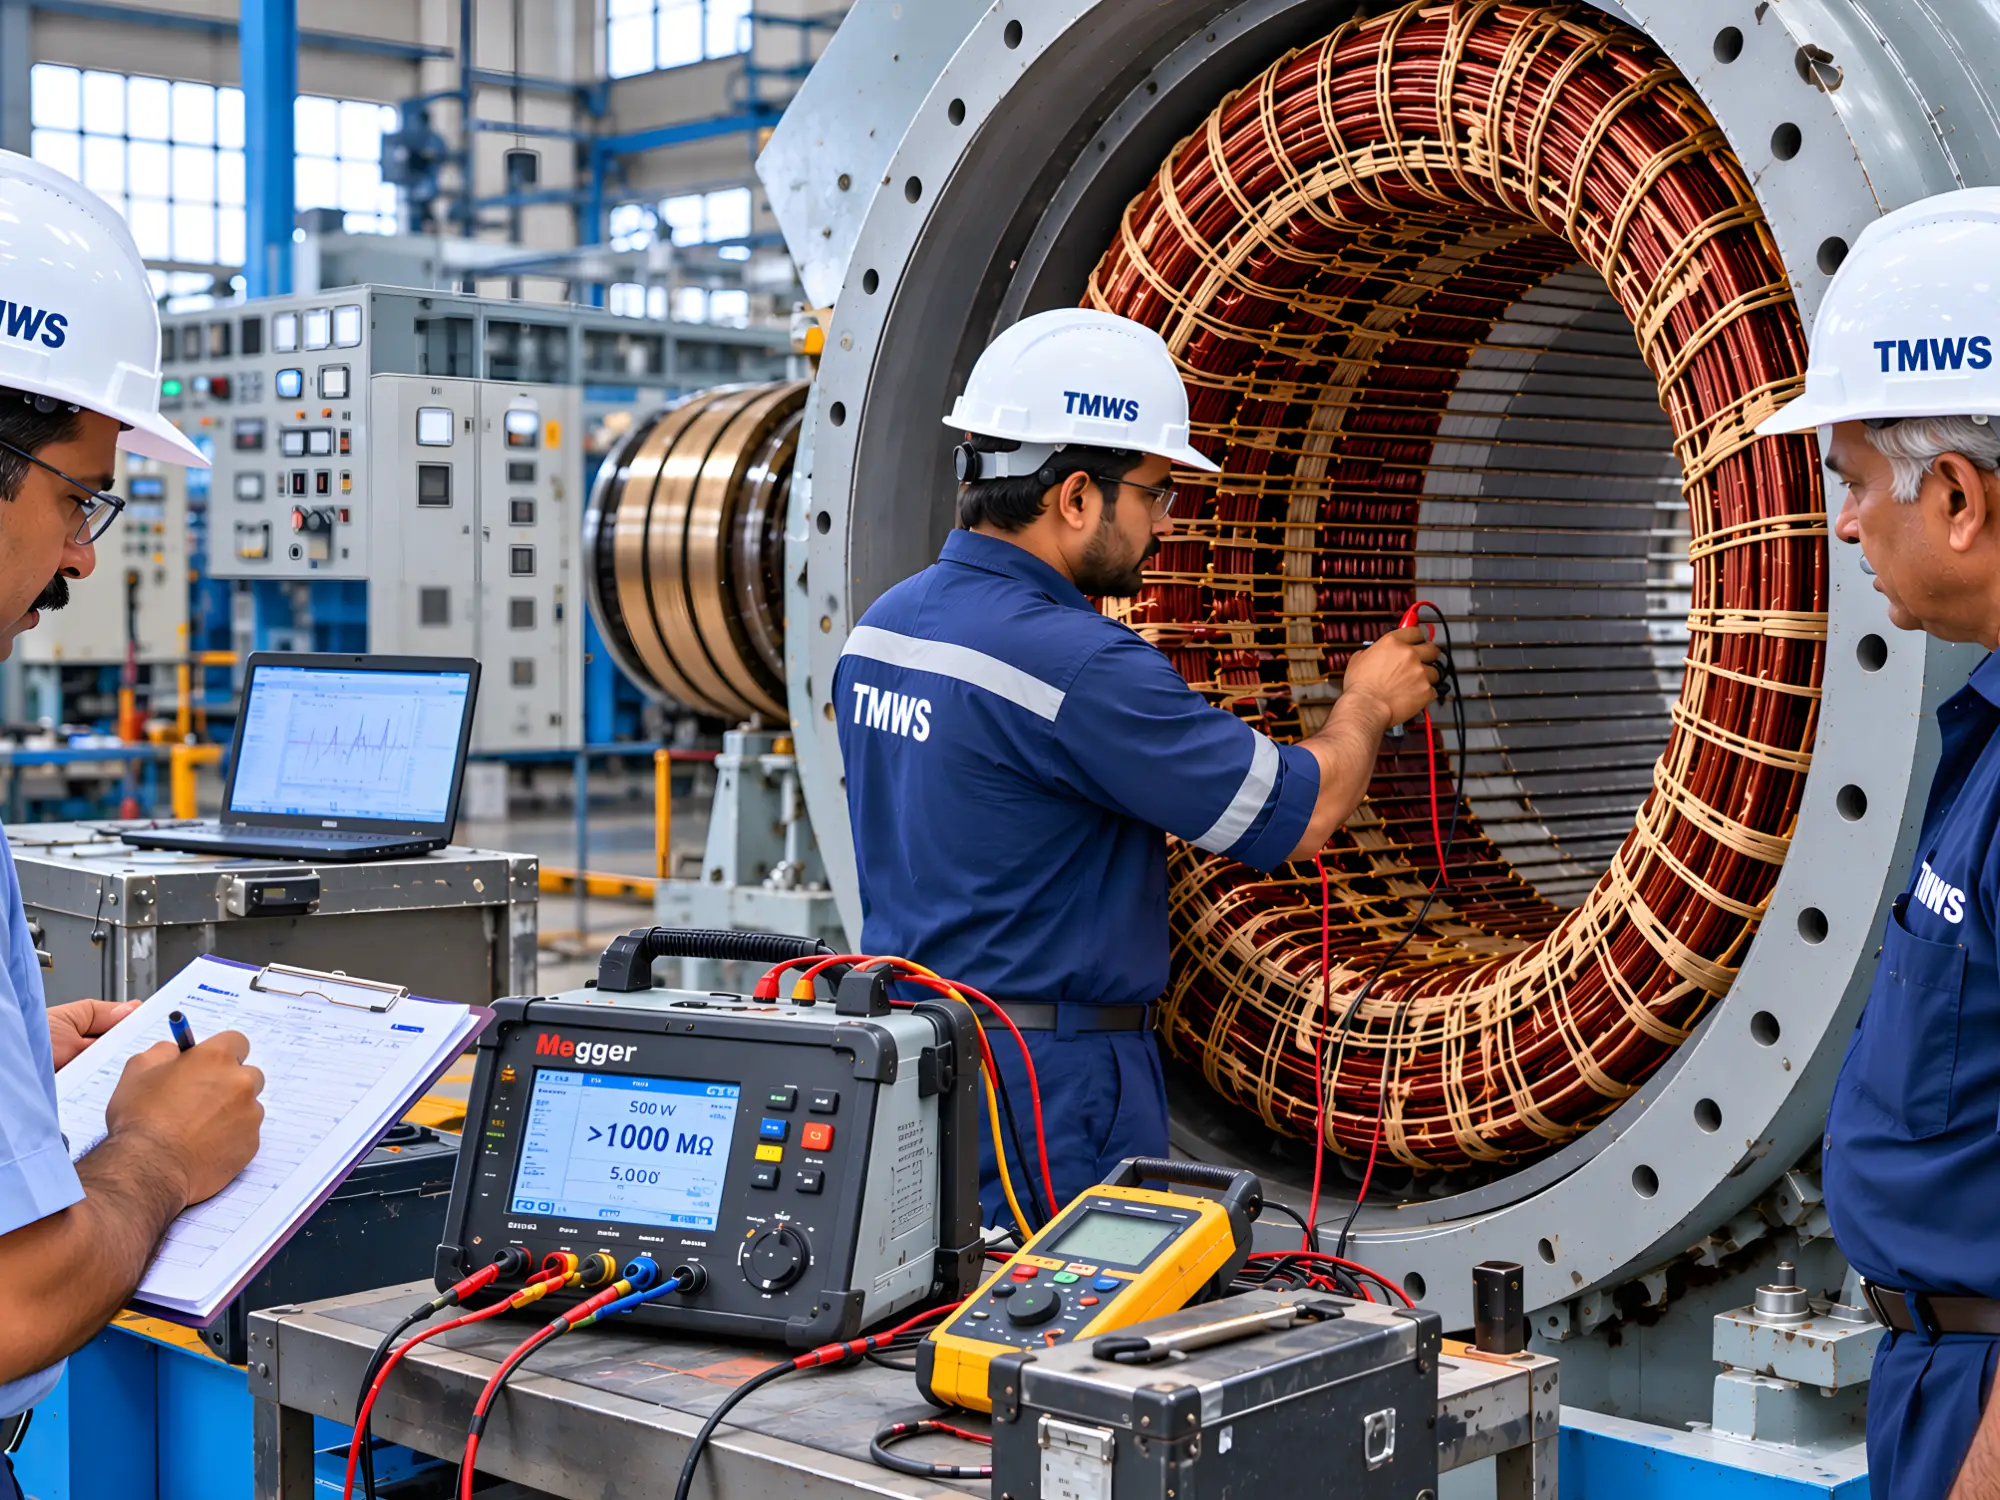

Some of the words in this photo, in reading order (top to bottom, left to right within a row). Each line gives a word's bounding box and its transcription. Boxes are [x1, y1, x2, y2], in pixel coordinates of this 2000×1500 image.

[0, 299, 69, 349] WS
[1873, 335, 1993, 372] TMWS
[1063, 390, 1140, 422] TMWS
[852, 682, 932, 742] TMWS
[535, 1032, 638, 1066] Megger
[660, 1103, 677, 1117] W
[587, 1122, 670, 1152] >1000
[675, 1132, 714, 1156] MΩ
